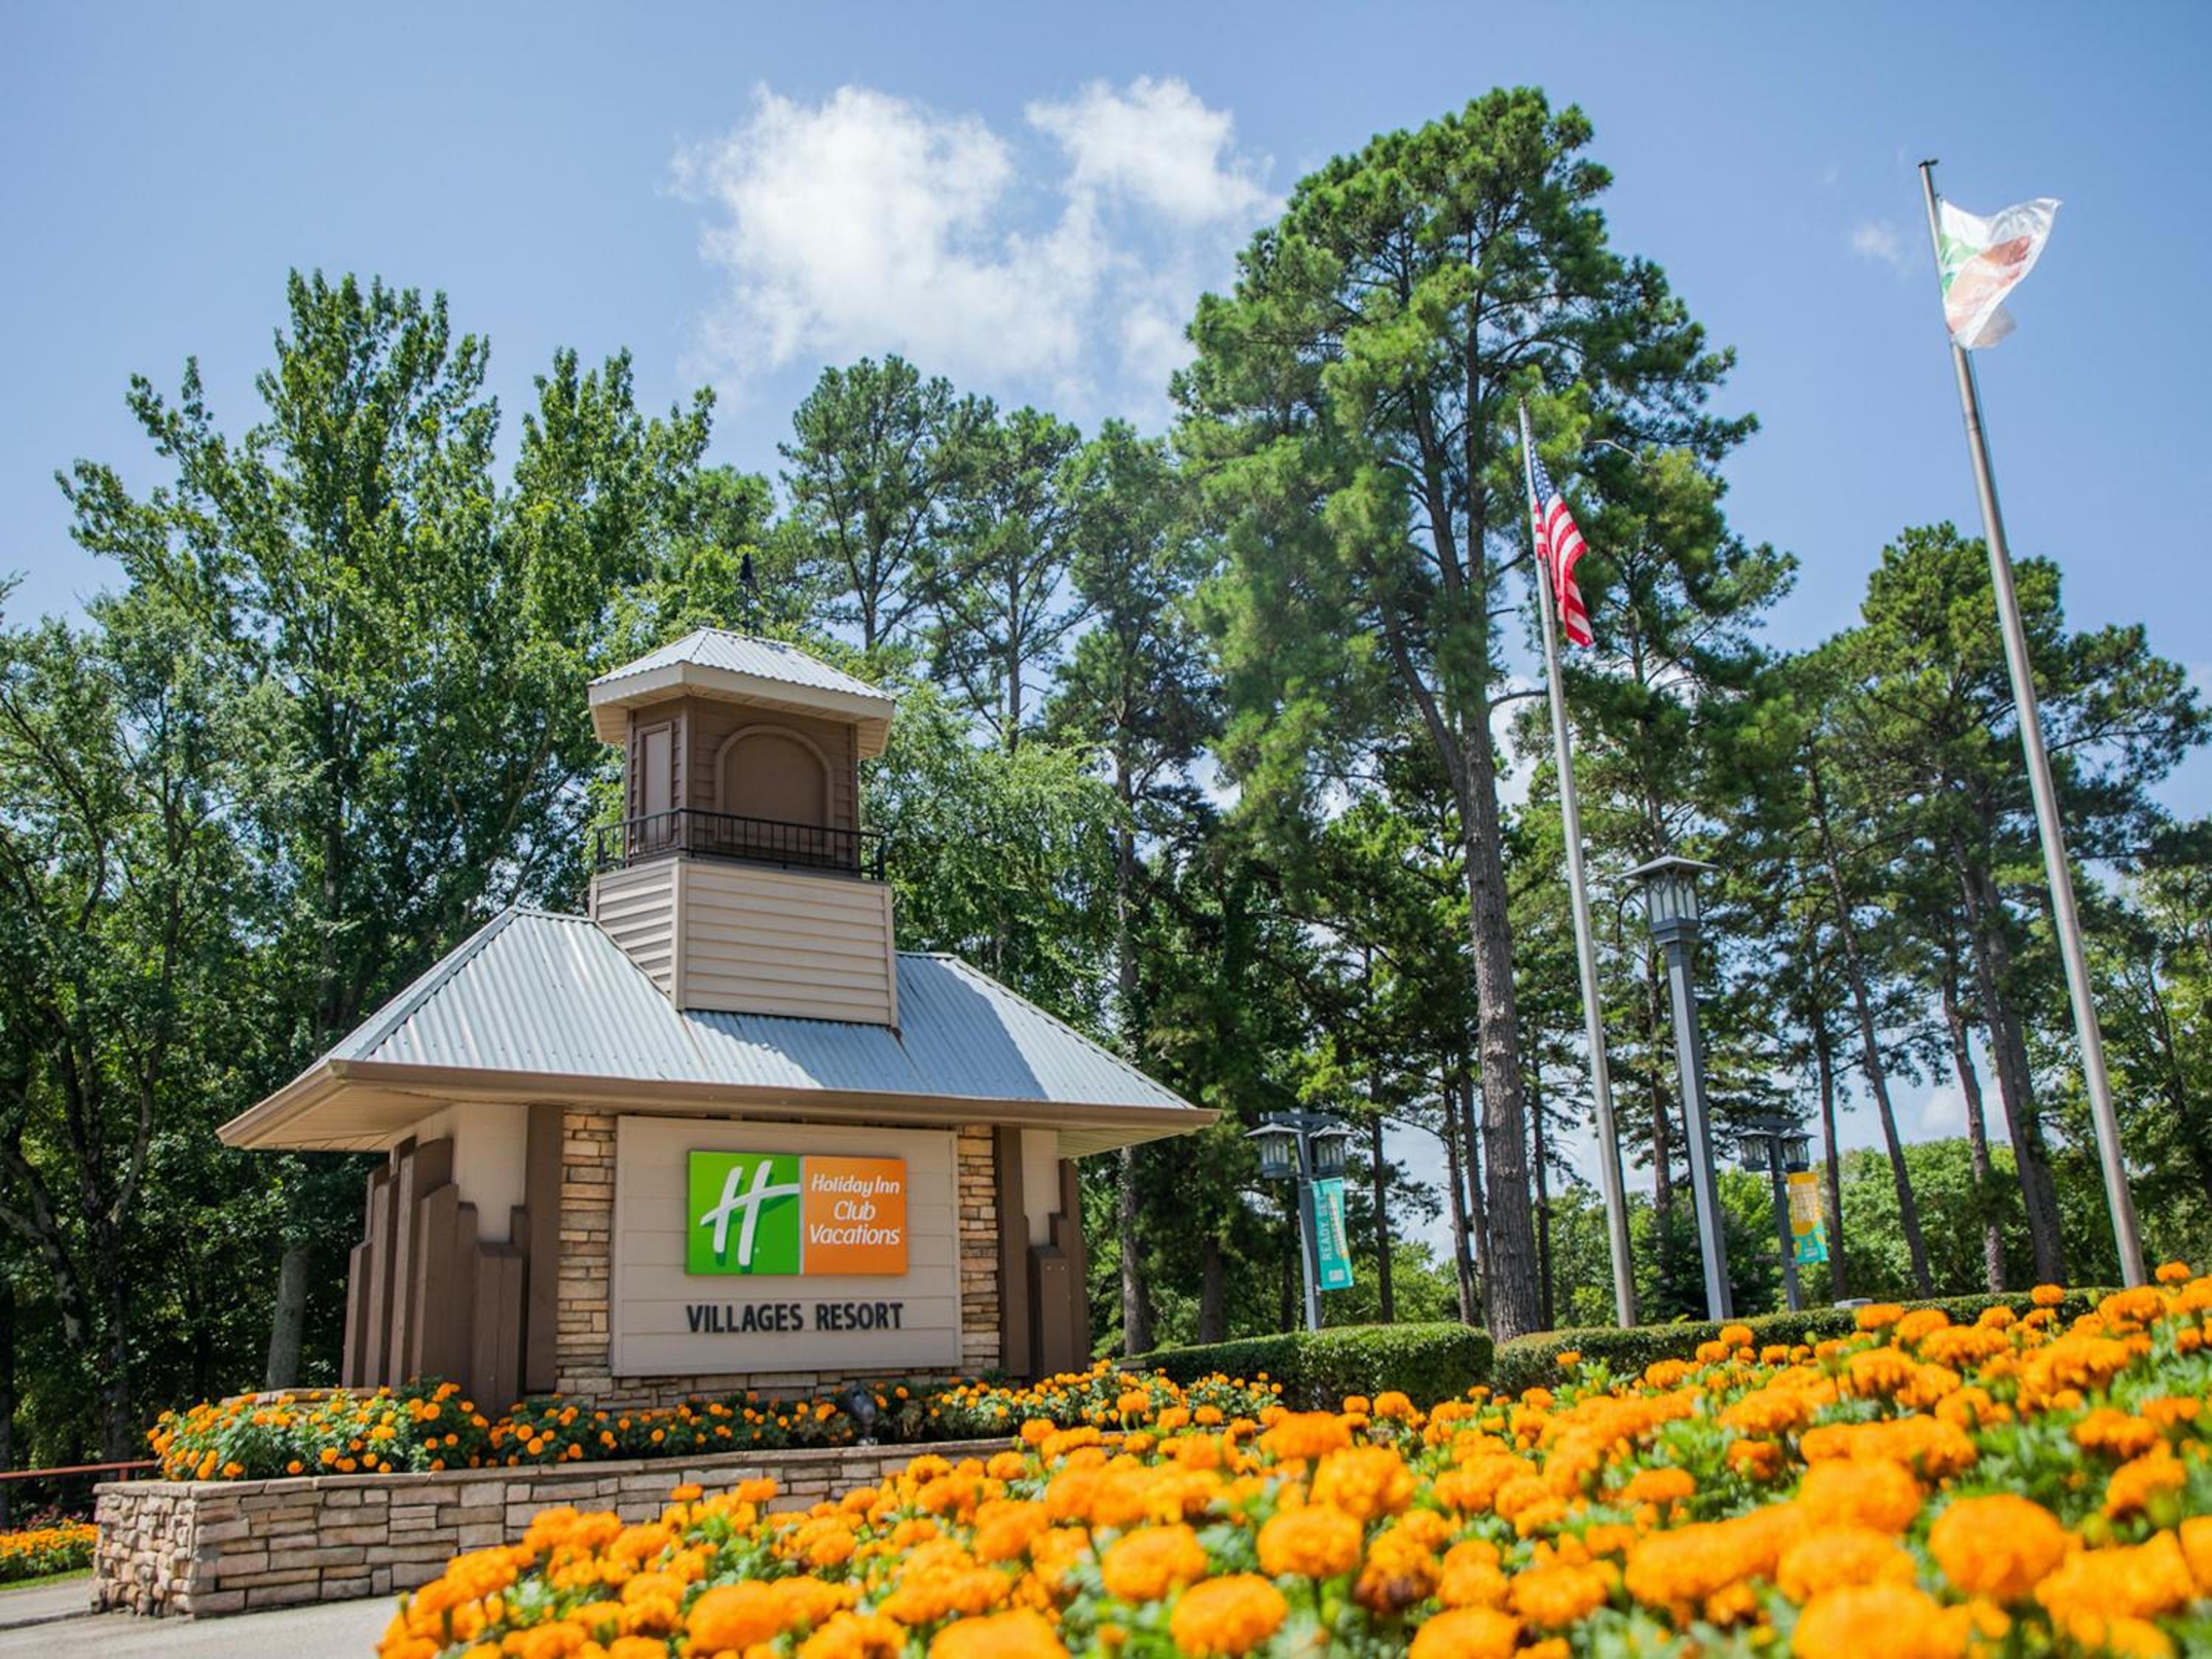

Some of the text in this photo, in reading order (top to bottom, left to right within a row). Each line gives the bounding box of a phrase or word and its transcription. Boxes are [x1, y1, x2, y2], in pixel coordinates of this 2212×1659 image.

[811, 1173, 900, 1197] Holiday Inn
[833, 1200, 876, 1221] Club
[810, 1224, 900, 1245] Vacations
[686, 1302, 903, 1333] VILLAGES RESORT
